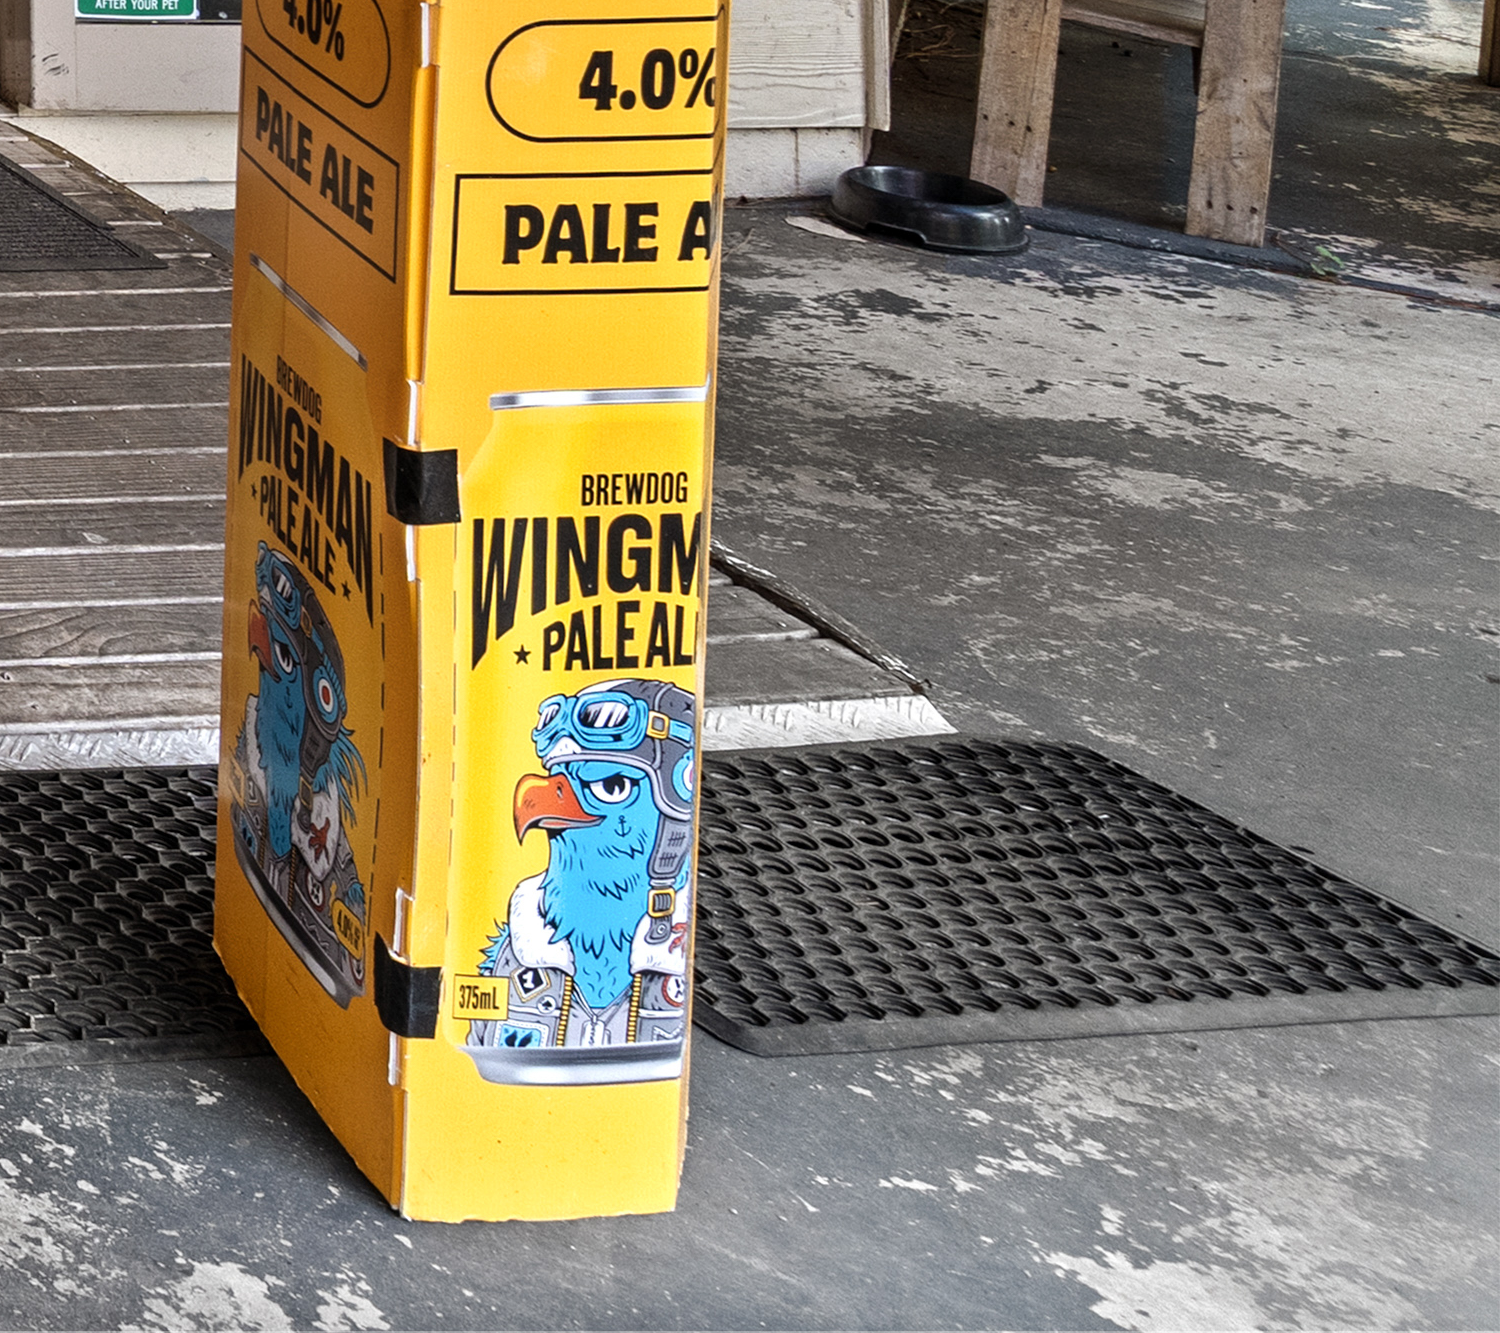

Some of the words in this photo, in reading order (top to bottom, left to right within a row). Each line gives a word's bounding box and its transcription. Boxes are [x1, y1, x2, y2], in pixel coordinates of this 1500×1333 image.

[129, 0, 160, 11] YOUR
[160, 0, 180, 12] PET
[255, 85, 315, 181] PALE
[319, 141, 376, 237] ALE
[502, 201, 660, 265] PALE
[274, 353, 323, 425] BREWDOG
[238, 351, 375, 625] WINGMAN
[579, 471, 689, 508] BREWDOG
[257, 480, 299, 550] PALE
[297, 513, 337, 596] ALE
[470, 511, 702, 672] WINGM
[540, 603, 642, 673] PALE
[647, 597, 700, 669] AL
[457, 983, 501, 1013] 375mL
